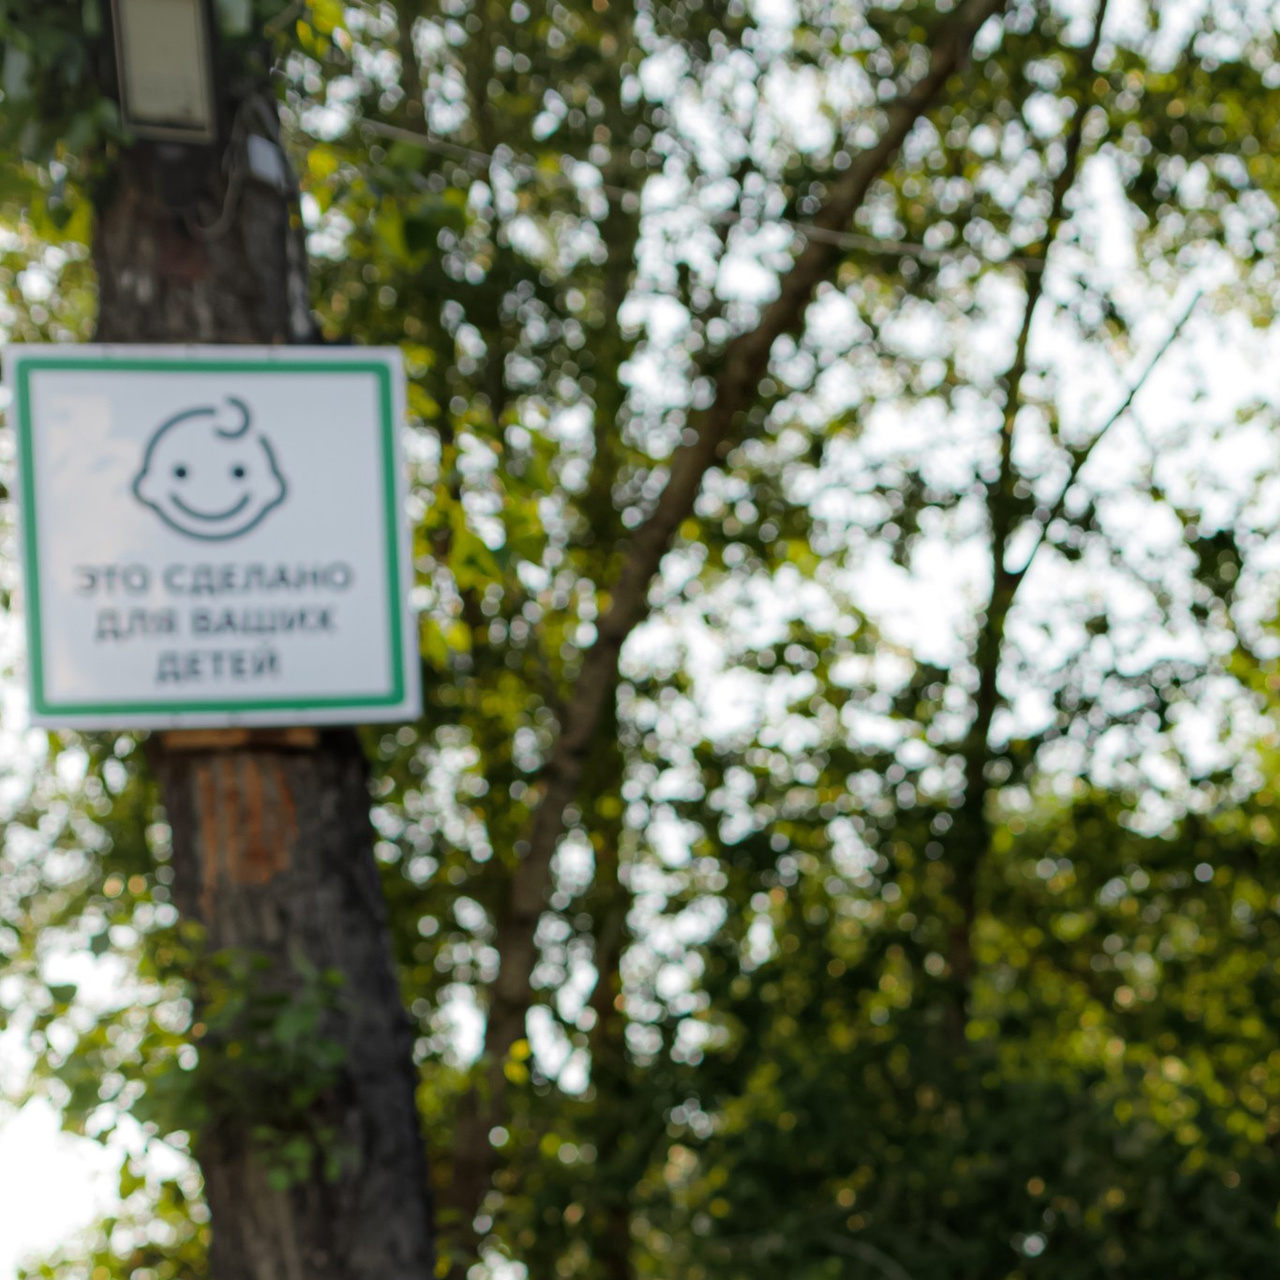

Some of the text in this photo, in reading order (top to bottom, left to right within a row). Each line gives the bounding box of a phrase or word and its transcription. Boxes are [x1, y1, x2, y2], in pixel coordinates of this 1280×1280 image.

[75, 561, 353, 597] ЭТО СДЕЛАНО
[96, 604, 337, 643] ДЛЯ ВАШИХ
[156, 643, 281, 684] ДЕТЕЙ
